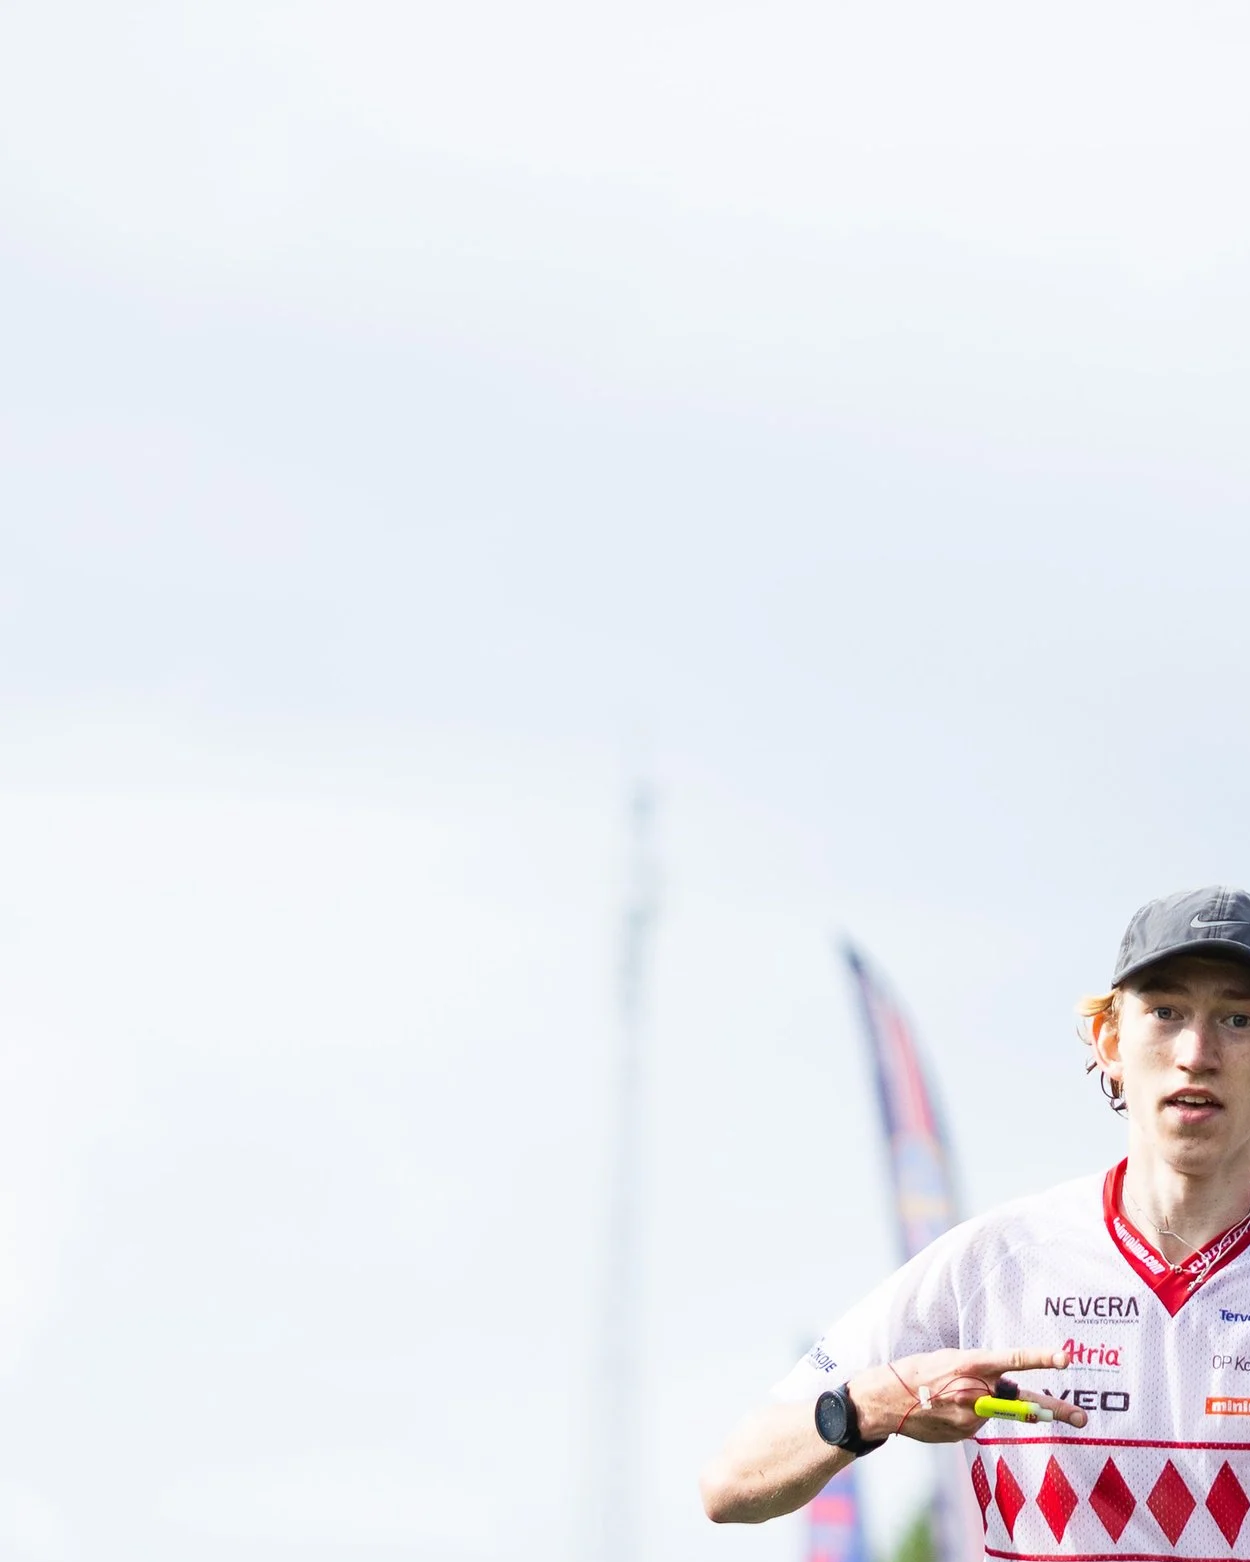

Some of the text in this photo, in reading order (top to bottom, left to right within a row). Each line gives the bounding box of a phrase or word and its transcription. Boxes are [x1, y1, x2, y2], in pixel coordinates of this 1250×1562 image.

[1044, 1297, 1140, 1317] NEVERA
[1062, 1338, 1121, 1366] Atria
[1212, 1355, 1232, 1369] OP
